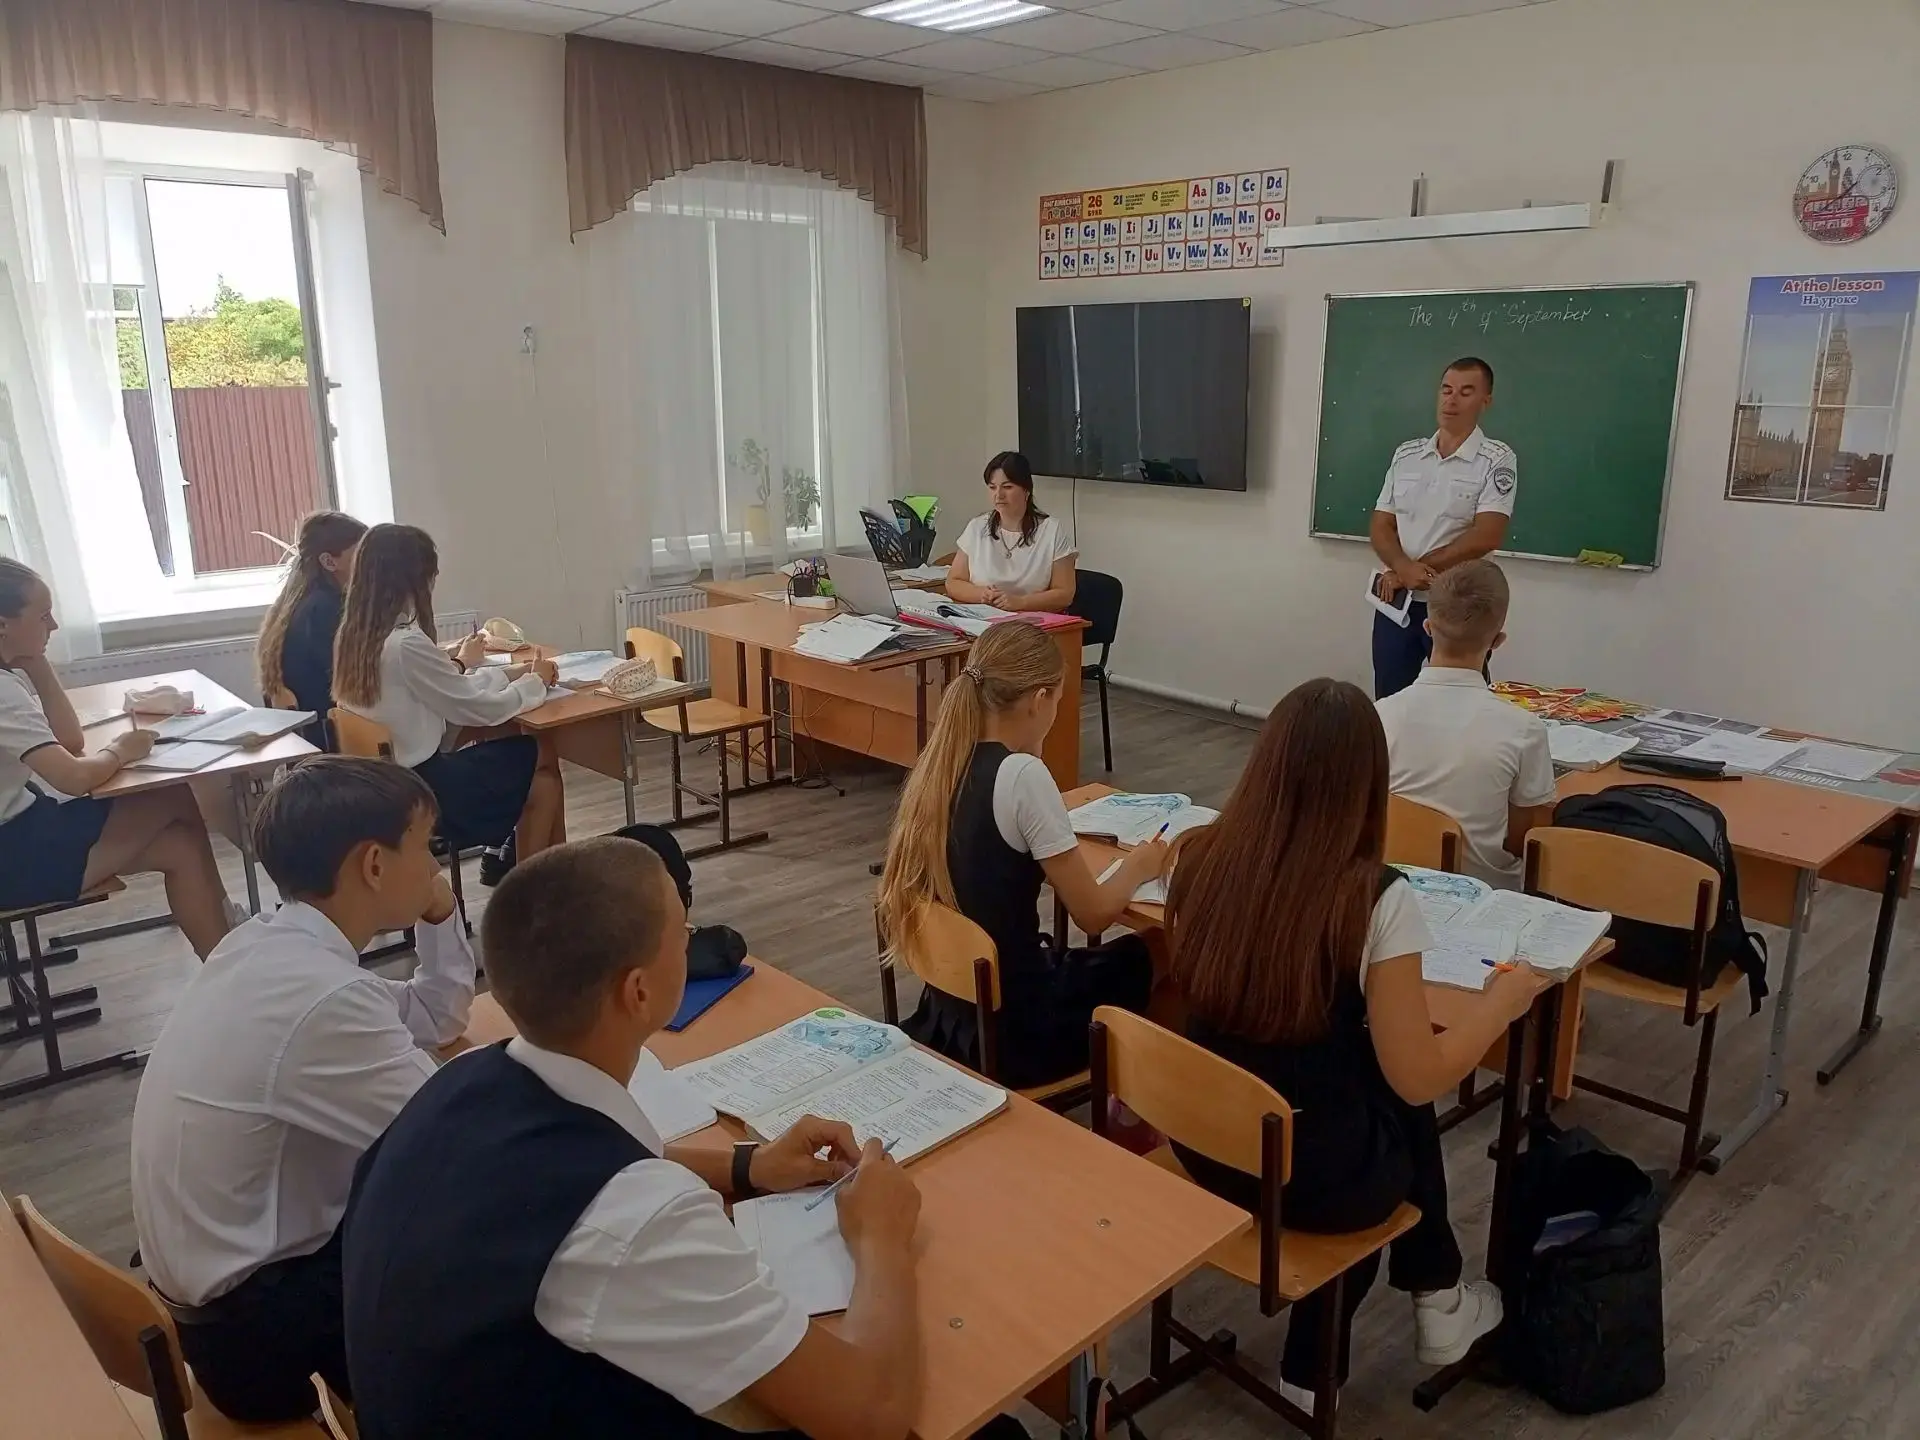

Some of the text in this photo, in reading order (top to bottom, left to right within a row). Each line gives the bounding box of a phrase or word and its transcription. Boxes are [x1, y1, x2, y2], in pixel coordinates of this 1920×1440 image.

[1843, 153, 1853, 161] 12
[1192, 176, 1283, 198] Aa Bb Cc Dd
[1087, 194, 1103, 208] 26
[1113, 194, 1123, 206] 21
[1151, 190, 1159, 202] 6
[1045, 228, 1056, 241] Ee
[1065, 226, 1075, 239] Ff
[1083, 225, 1096, 239] Gg
[1103, 223, 1117, 236] Hh
[1126, 221, 1136, 234] Ii
[1147, 219, 1158, 234] Jj
[1168, 217, 1182, 230] Kk
[1212, 212, 1232, 226] Mm
[1238, 210, 1255, 224] Nn
[1264, 208, 1281, 222] Oo
[1044, 256, 1056, 269] Pp
[1062, 255, 1076, 269] Qq
[1083, 253, 1095, 266] Rr
[1103, 252, 1115, 264] Ss
[1125, 250, 1136, 263] Tt
[1145, 249, 1159, 262] Uu
[1167, 247, 1181, 260] Vv
[1187, 244, 1207, 258] Ww
[1213, 243, 1229, 257] Xx
[1238, 241, 1253, 258] Yy
[1781, 277, 1884, 293] At the lesson
[1802, 294, 1858, 308] На уроке
[1409, 304, 1432, 327] The
[1505, 302, 1592, 333] September
